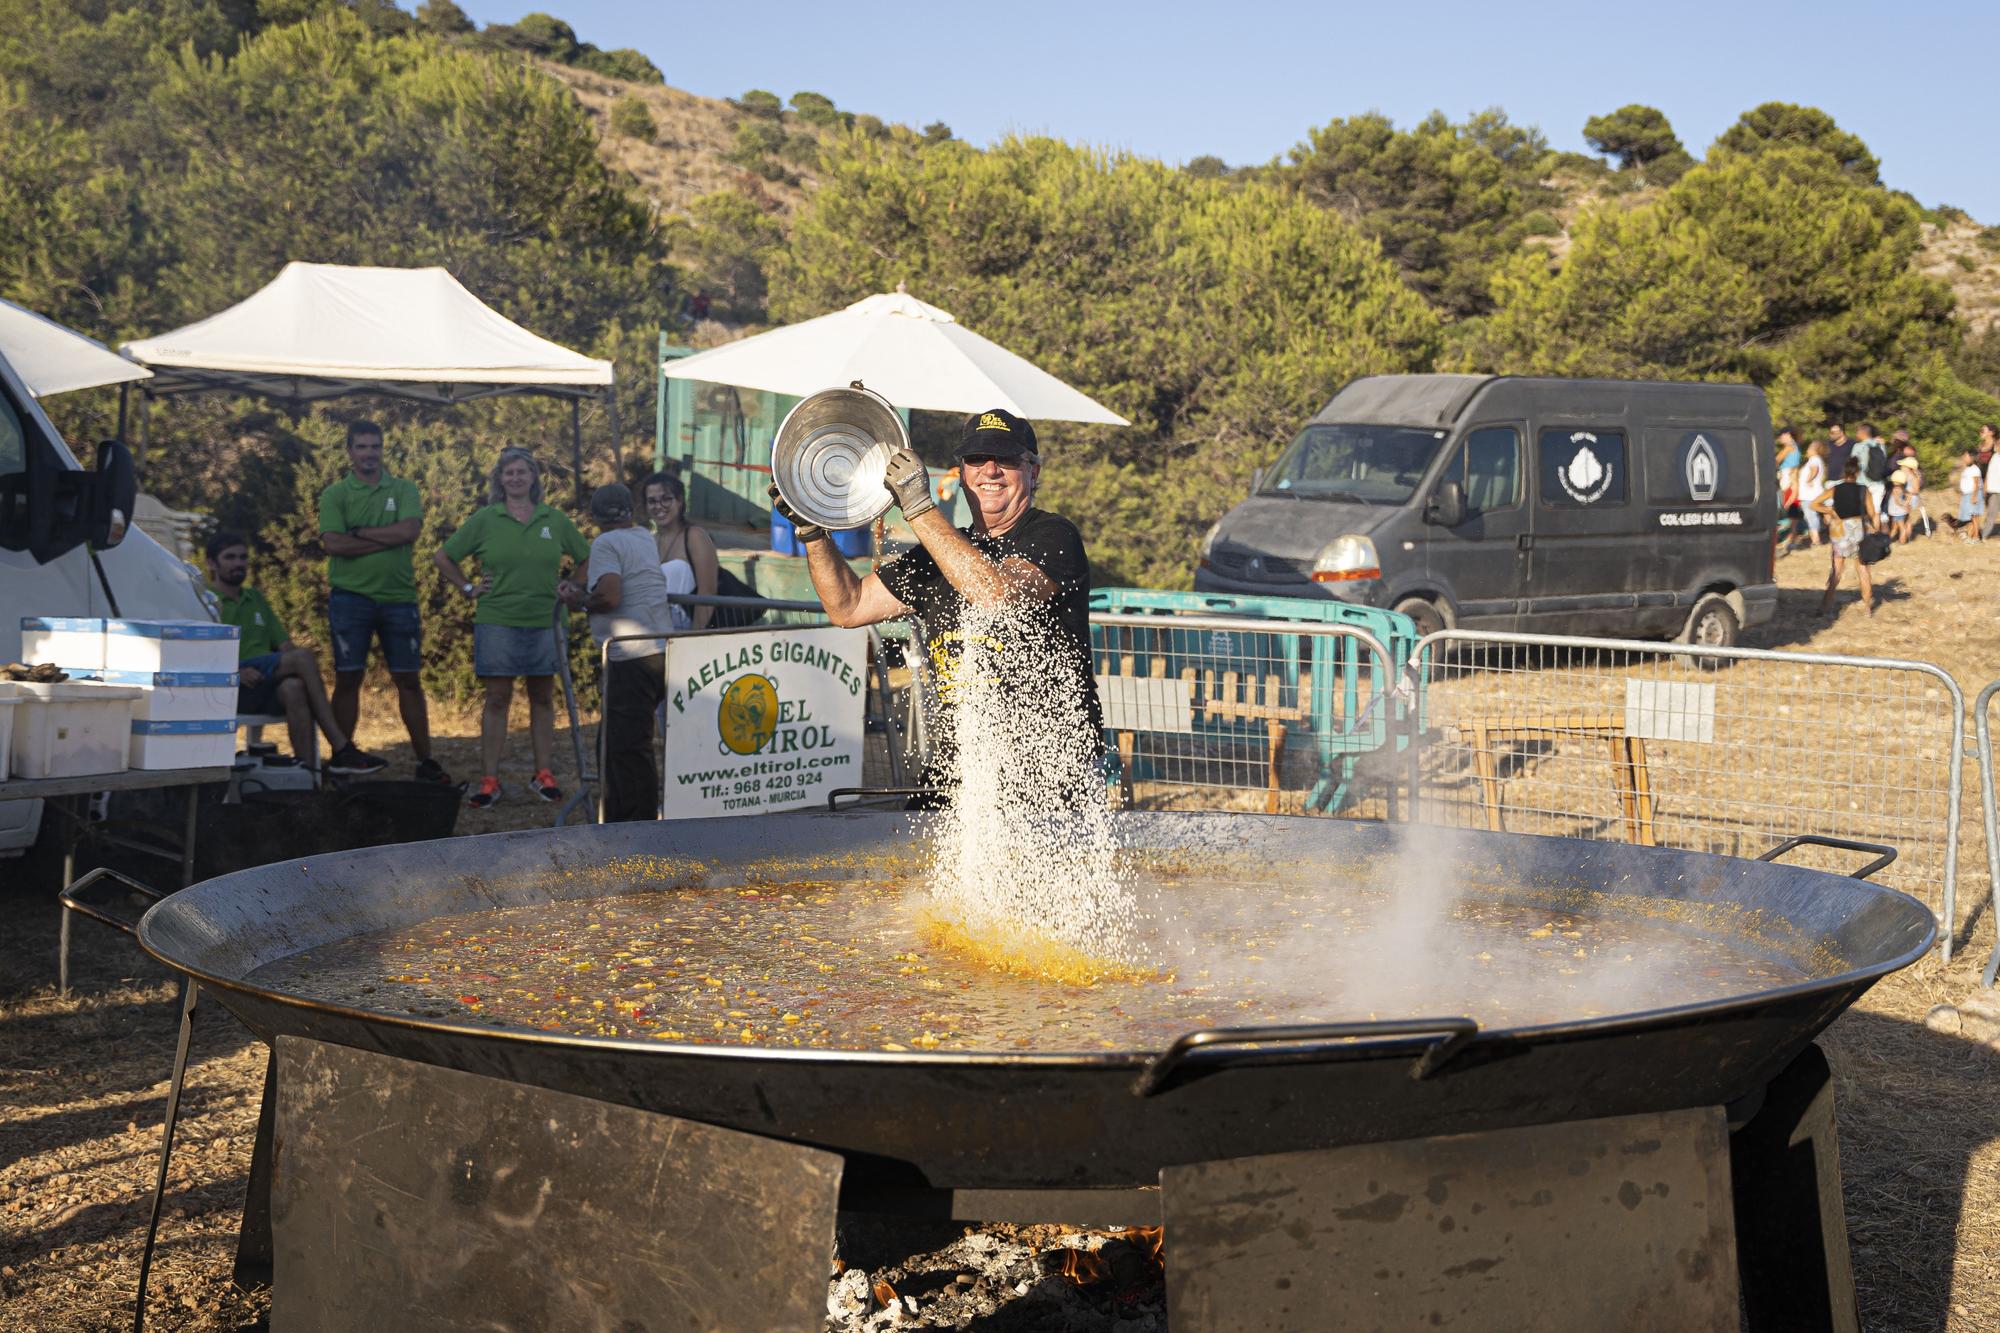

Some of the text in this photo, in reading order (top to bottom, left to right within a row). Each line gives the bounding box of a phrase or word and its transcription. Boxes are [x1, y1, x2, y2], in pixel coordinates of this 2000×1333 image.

[672, 644, 764, 714] PAELLAS
[770, 641, 861, 696] GIGANTES
[779, 699, 813, 724] EL
[752, 725, 836, 756] TIROL
[677, 753, 850, 785] www.eltirol.com
[700, 772, 823, 799] Tlf.: 968 420 924
[722, 798, 761, 811] TOTANA
[768, 789, 807, 804] MURCIA
